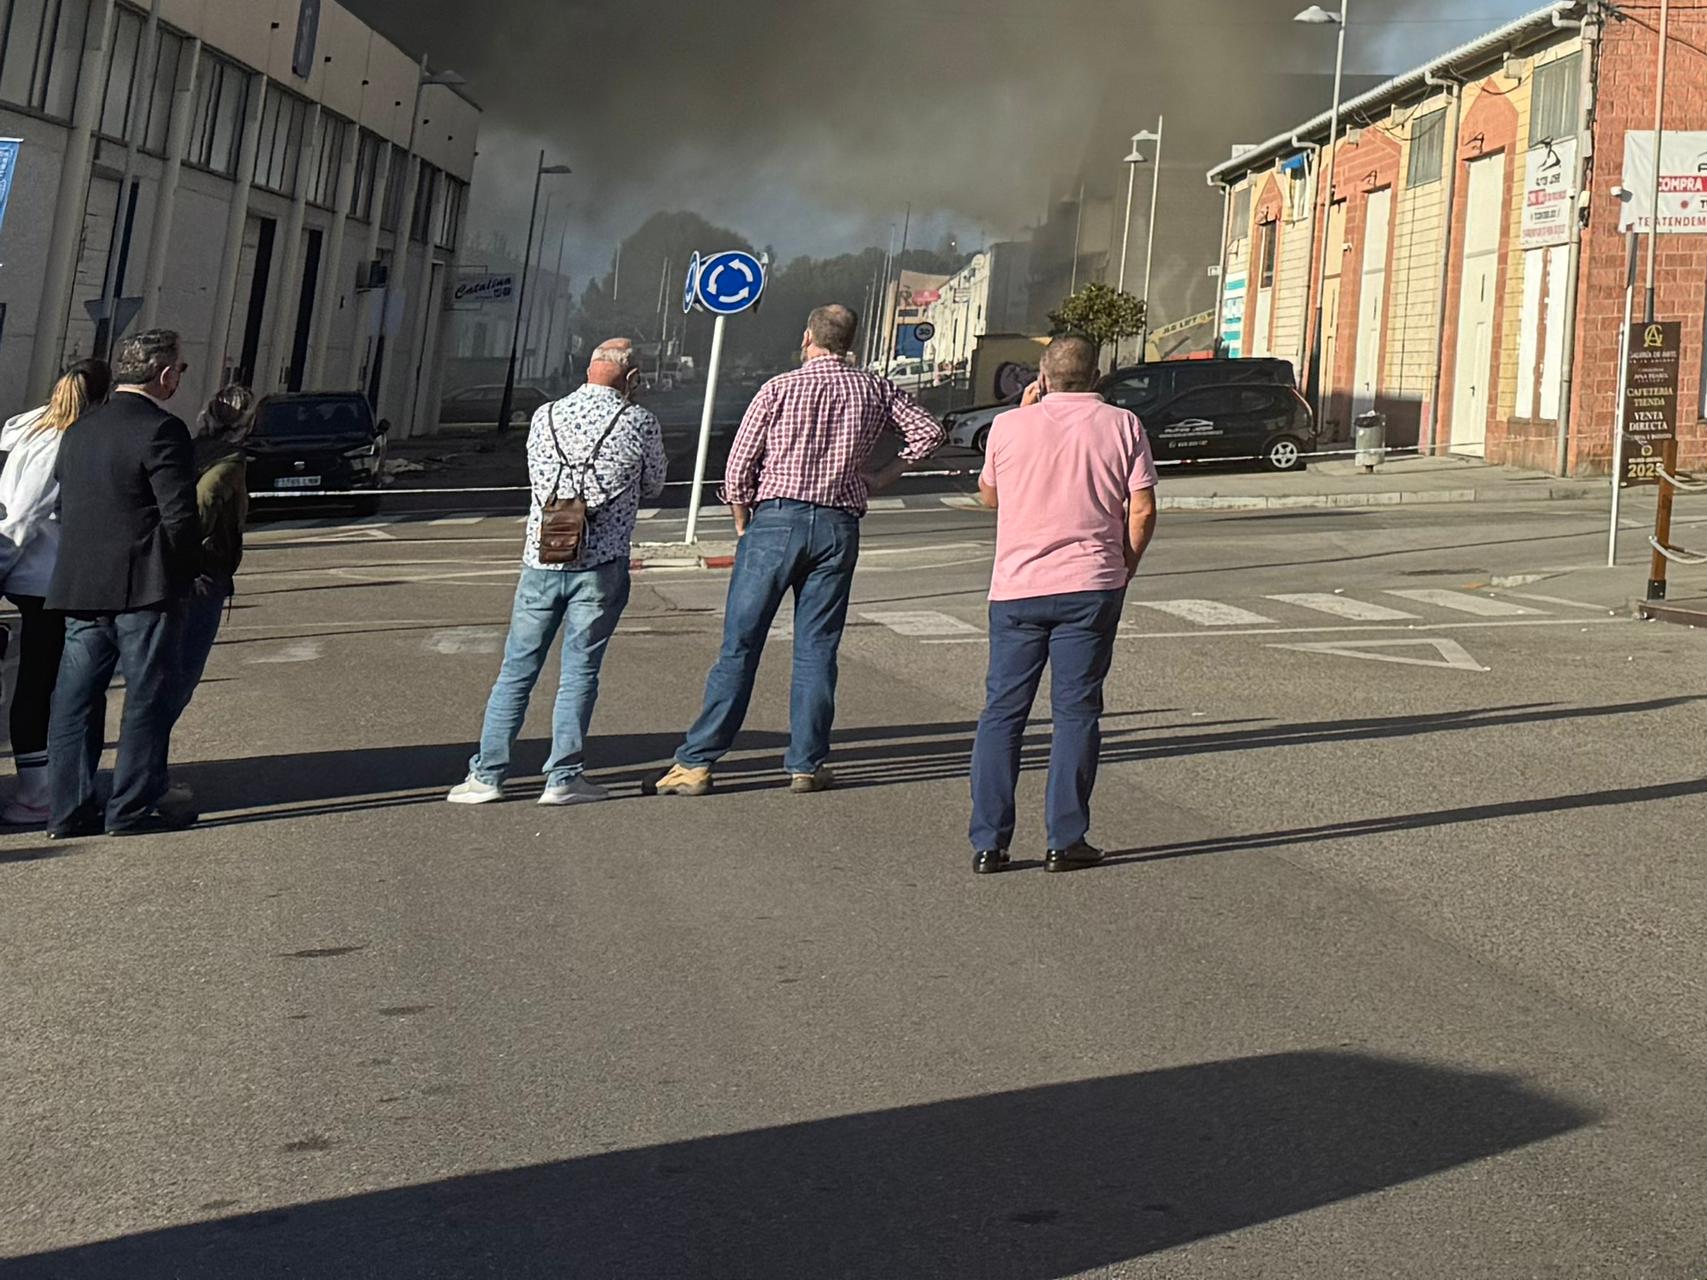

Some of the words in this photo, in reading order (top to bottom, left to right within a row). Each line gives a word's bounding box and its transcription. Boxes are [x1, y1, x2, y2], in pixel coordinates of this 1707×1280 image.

[1633, 397, 1665, 407] TIENDA
[1634, 411, 1663, 420] VENTA
[1629, 421, 1668, 431] DIRECTA
